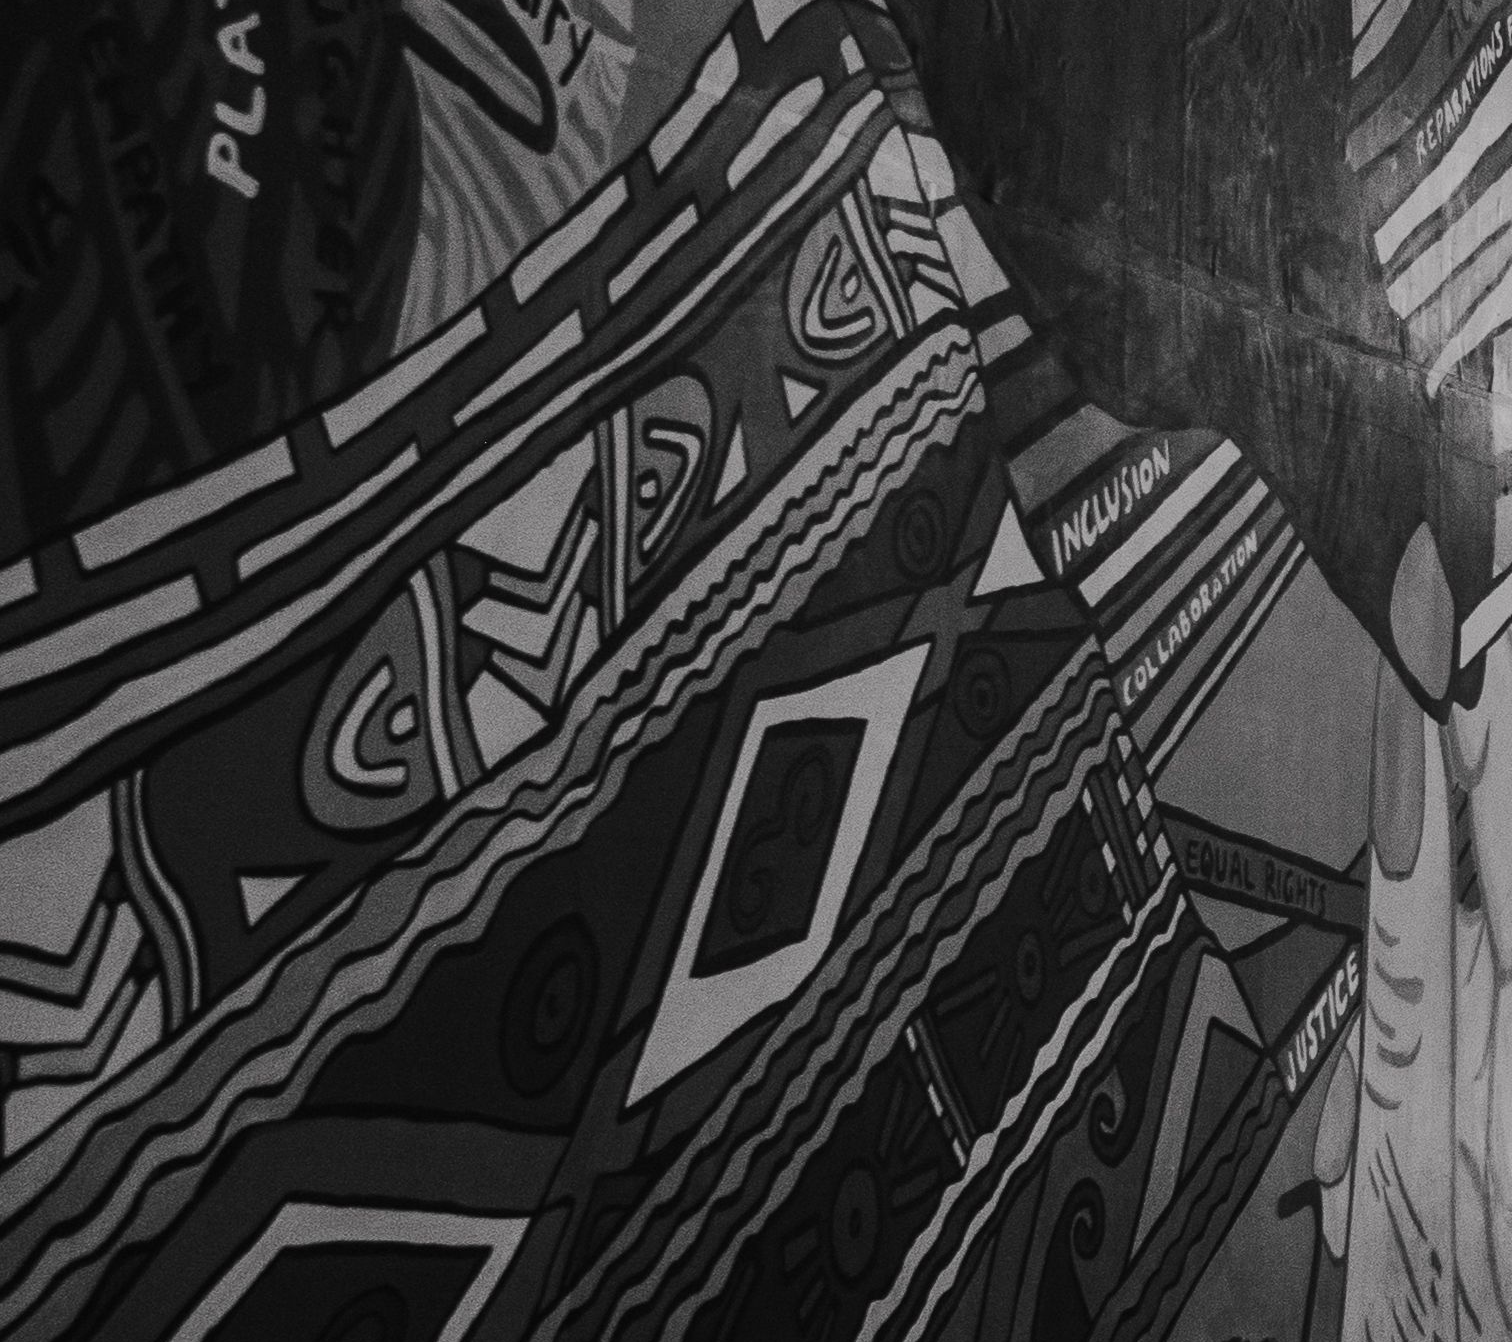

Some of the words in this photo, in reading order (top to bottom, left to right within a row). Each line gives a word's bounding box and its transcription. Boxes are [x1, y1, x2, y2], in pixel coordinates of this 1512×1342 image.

[1413, 21, 1505, 165] REPARATIONS
[1049, 439, 1173, 578] INCLUSION
[1121, 529, 1259, 708] COLLABORATION
[1184, 839, 1257, 892] EQUAL
[1262, 861, 1329, 915] RIGHTS
[1286, 949, 1361, 1093] JUSTICE
